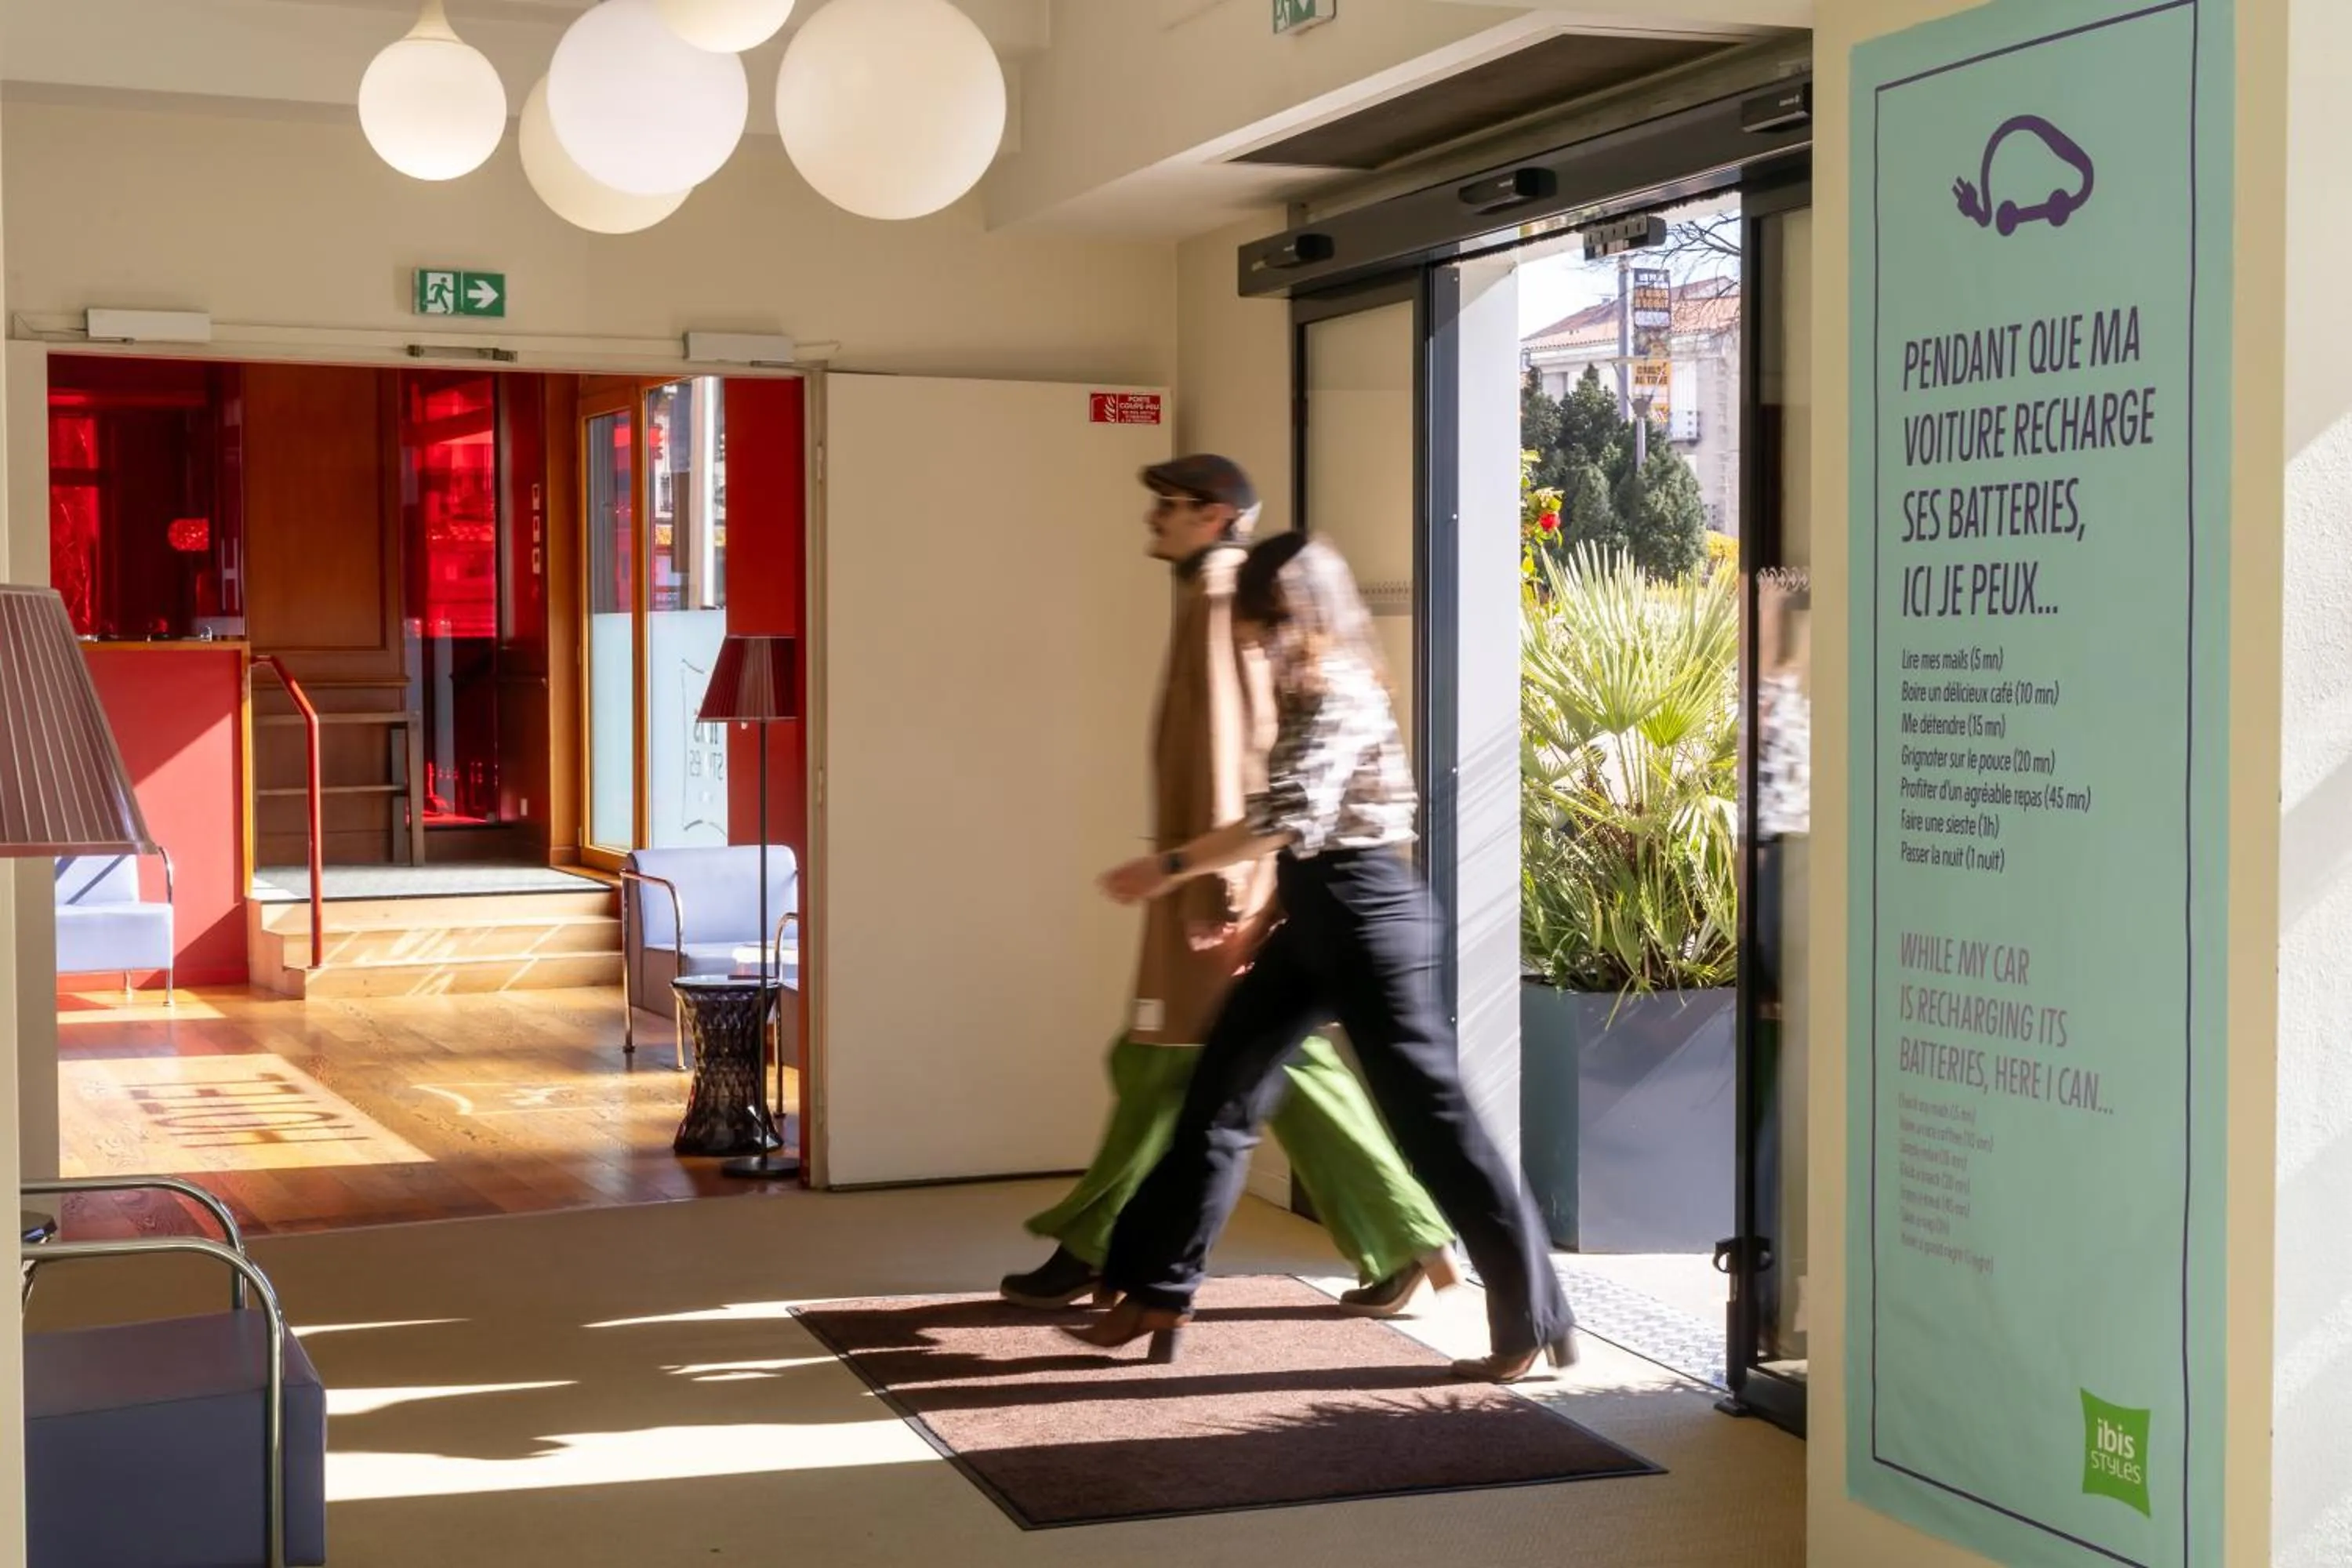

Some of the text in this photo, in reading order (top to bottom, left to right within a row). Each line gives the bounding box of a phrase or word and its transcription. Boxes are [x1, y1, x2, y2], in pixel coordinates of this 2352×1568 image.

[1904, 306, 2140, 391] PENDANT QUE MA
[1904, 387, 2156, 466] VOITURE RECHARGE
[1902, 477, 2086, 543] SES BATTERIES,
[1904, 561, 2058, 617] ICI JE PEUX...
[1901, 645, 2003, 673] Lire mes mails (5 mn)
[1901, 680, 2060, 706] Boire un délicieux café (10 mn)
[1902, 713, 2005, 739] Me détendre (15 mn)
[1901, 745, 2055, 775] Grignoter sur le pouce (20 mn)
[1900, 777, 2091, 813] Profiter d'un agréable repas (45 mn)
[1901, 808, 1999, 839] Faire une sieste (1h)
[1901, 840, 2005, 873] Passer la nuit (1 nuit)
[1900, 931, 2030, 985] WHILE MY CAR
[1900, 985, 2067, 1047] IS RECHARGING ITS
[1900, 1036, 2114, 1115] BATTERIES, HERE I CAN...
[2097, 1417, 2135, 1458] ibis
